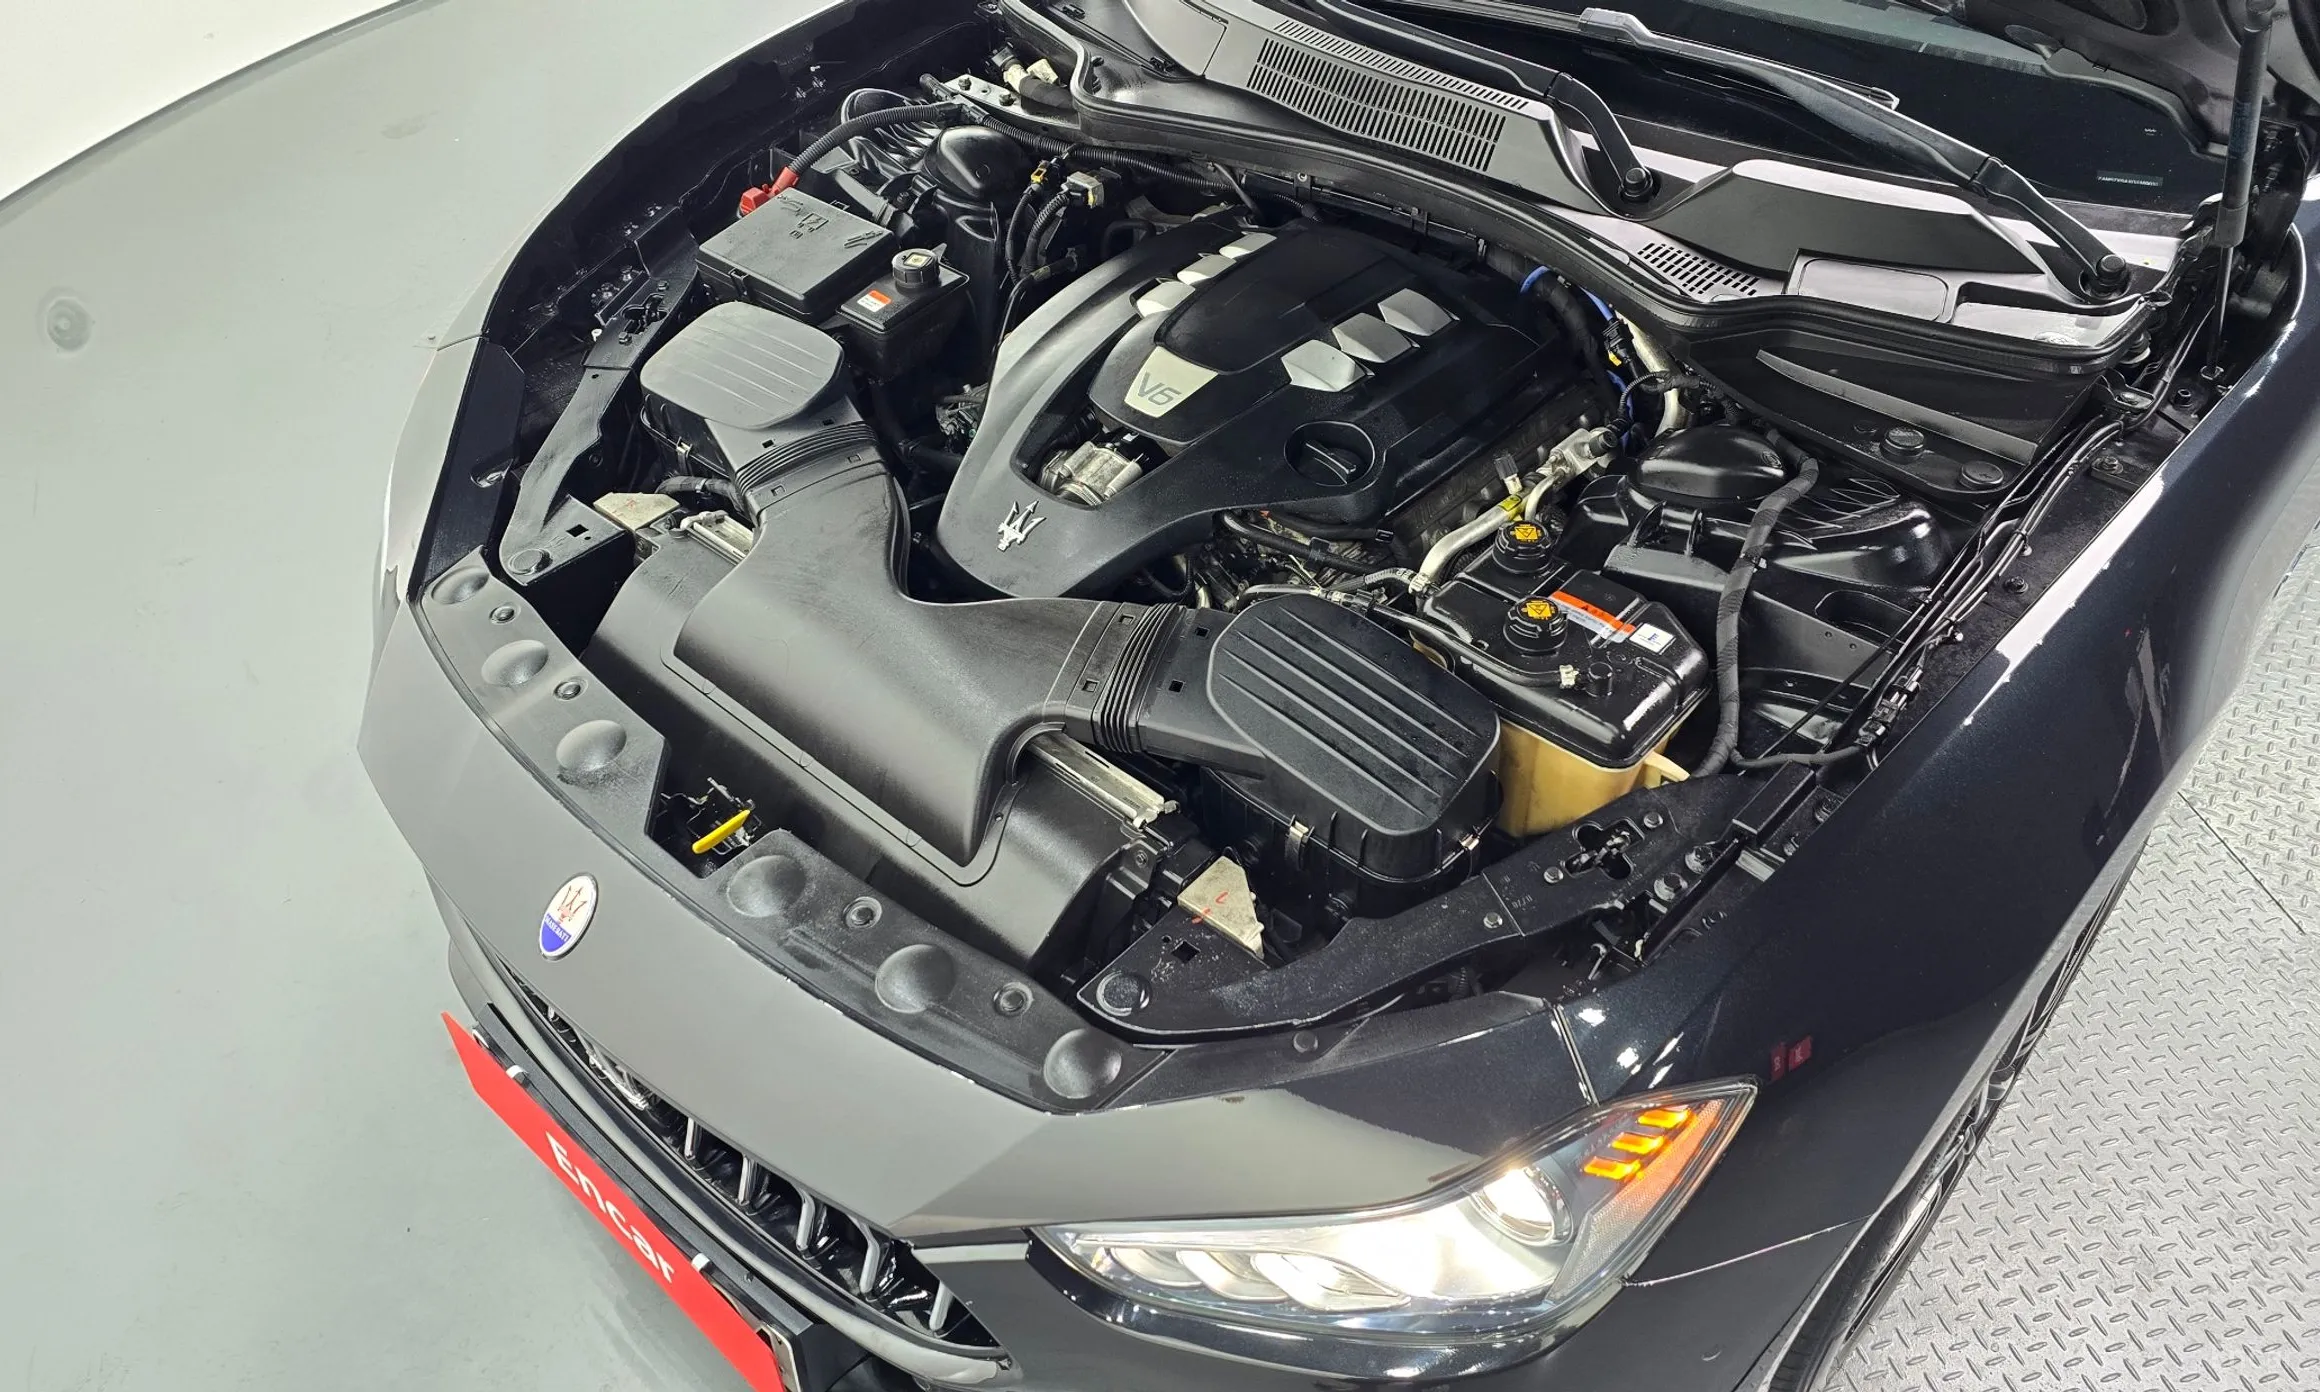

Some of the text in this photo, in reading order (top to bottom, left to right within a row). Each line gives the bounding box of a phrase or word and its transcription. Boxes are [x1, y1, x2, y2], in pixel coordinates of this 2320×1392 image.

[1138, 371, 1182, 405] V6
[544, 914, 570, 942] MASERATI
[546, 1131, 675, 1284] Encar
